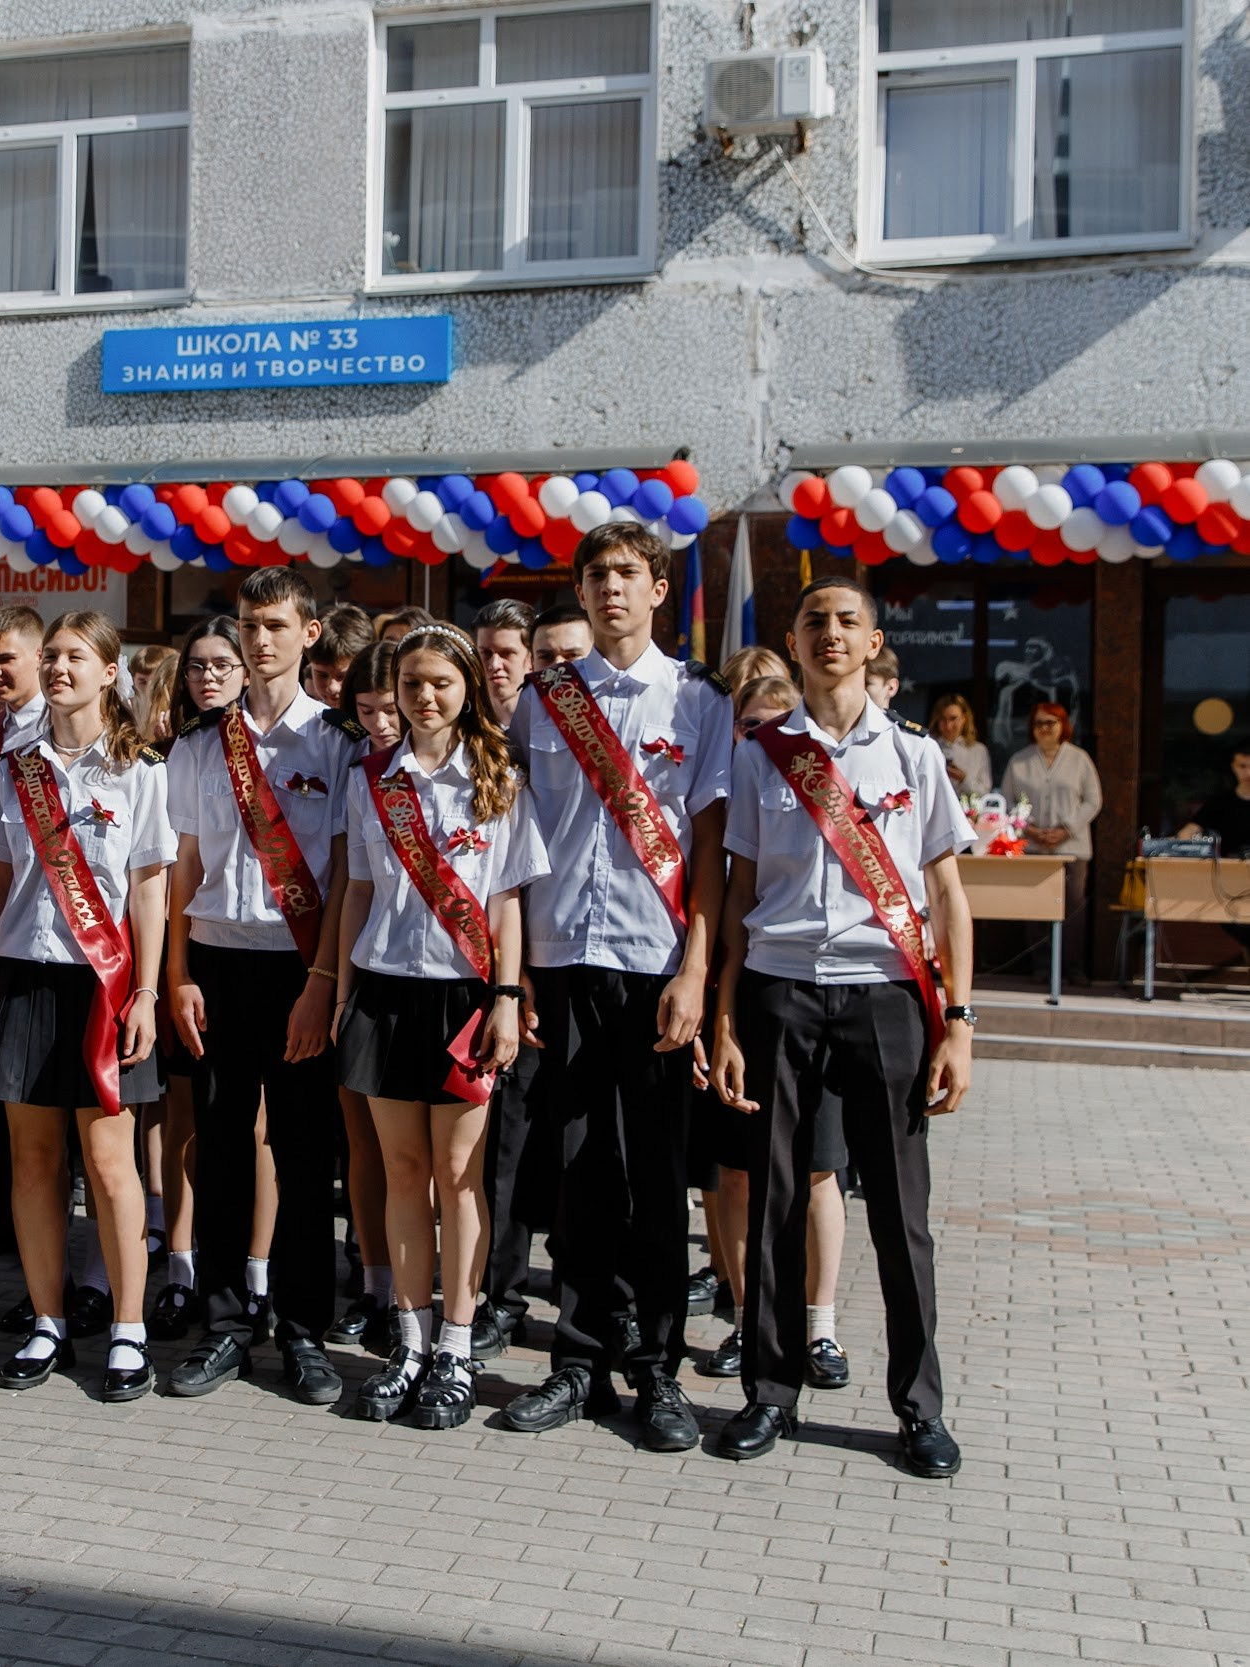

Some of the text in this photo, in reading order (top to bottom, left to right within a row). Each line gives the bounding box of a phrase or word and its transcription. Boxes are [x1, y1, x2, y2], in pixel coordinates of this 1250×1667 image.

[177, 327, 358, 356] ШКОЛА № 33
[122, 354, 426, 383] ЗНАНИЯ И ТВОРЧЕСТВО
[612, 790, 649, 811] 9
[257, 836, 290, 854] 9
[44, 848, 78, 867] 9
[439, 898, 473, 917] 9
[877, 893, 910, 916] 9
